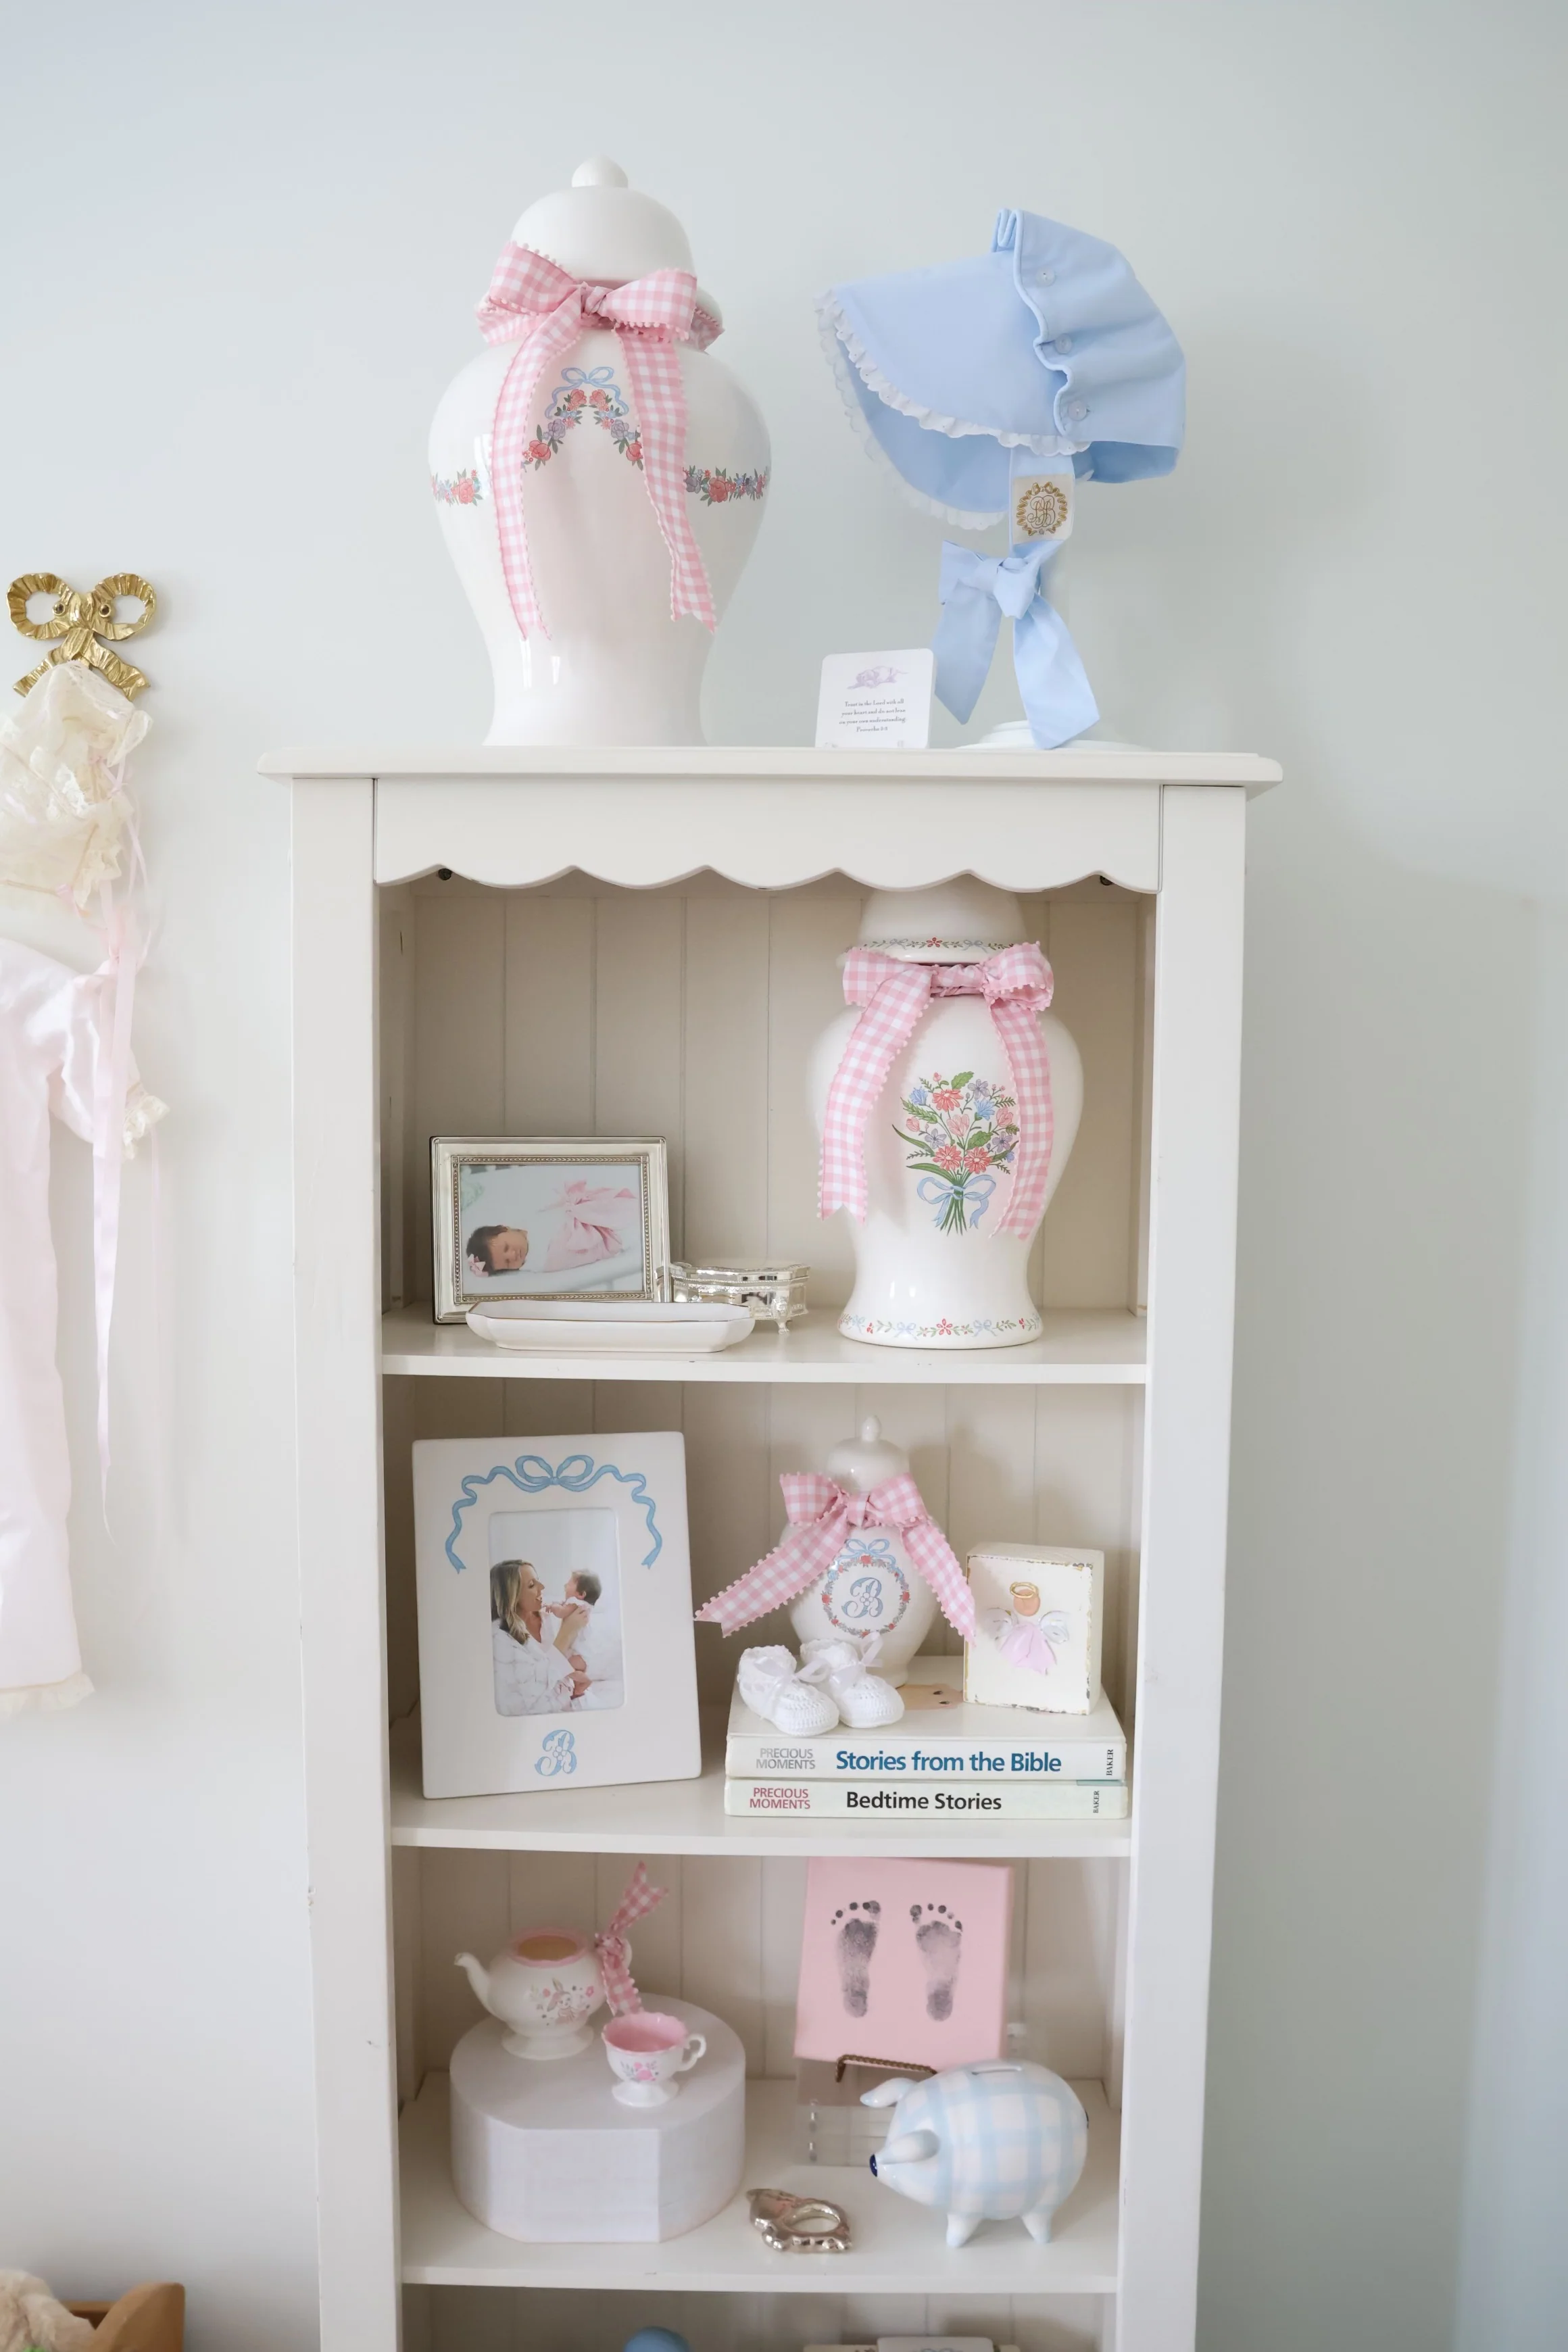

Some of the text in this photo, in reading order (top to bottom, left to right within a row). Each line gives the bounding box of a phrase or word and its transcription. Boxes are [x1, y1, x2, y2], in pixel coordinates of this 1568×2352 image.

[760, 1748, 814, 1759] PRECIOUS
[756, 1759, 816, 1769] MOMENTS
[836, 1750, 1062, 1771] Stories from the Bible
[1106, 1748, 1114, 1776] BAKER
[753, 1787, 809, 1798] PRECIOUS
[750, 1798, 811, 1809] MOMENTS
[847, 1791, 1002, 1810] Bedtime Stories
